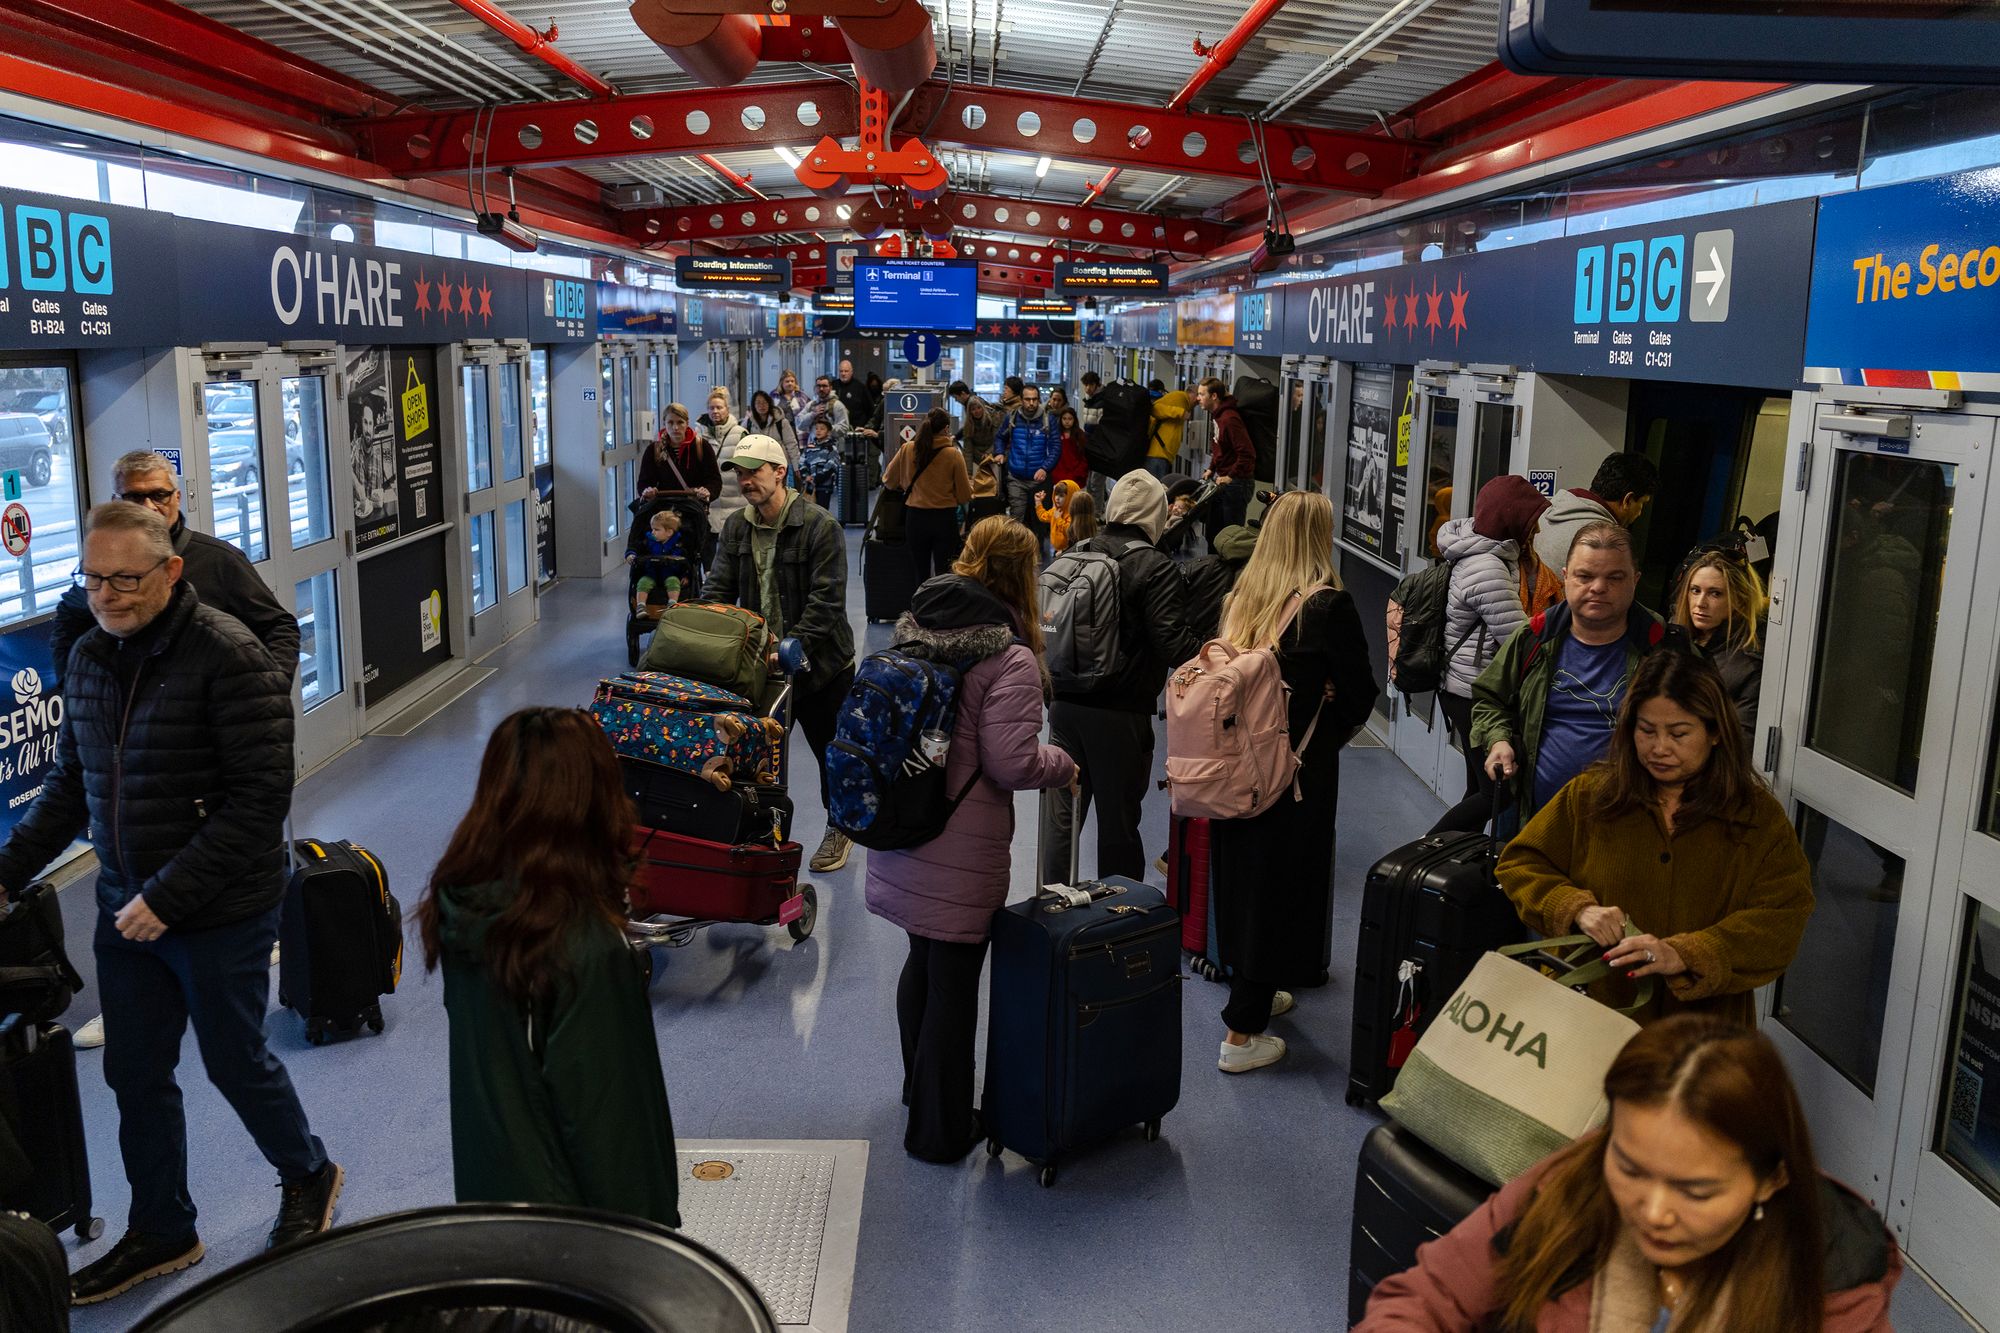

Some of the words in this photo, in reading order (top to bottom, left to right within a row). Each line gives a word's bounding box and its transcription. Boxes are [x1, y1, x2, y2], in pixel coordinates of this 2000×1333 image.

[27, 217, 57, 279] B
[78, 225, 105, 284] C
[692, 260, 728, 271] Boarding
[729, 261, 773, 271] Information
[882, 270, 921, 280] Terminal
[1072, 266, 1107, 276] Boarding
[1109, 267, 1152, 276] Information
[271, 246, 403, 327] O'HARE
[1583, 256, 1596, 312] 1
[1616, 252, 1636, 312] B
[1652, 246, 1677, 310] C
[1853, 253, 1911, 304] The
[32, 298, 60, 314] Gates
[82, 301, 108, 316] Gates
[568, 286, 574, 313] B
[577, 287, 584, 314] C
[1309, 282, 1375, 344] O'HARE
[30, 319, 65, 334] B1-B24
[80, 321, 111, 335] C1-C31
[1574, 331, 1600, 344] Terminal
[1612, 330, 1632, 345] Gates
[1649, 330, 1671, 346] Gates
[1609, 350, 1633, 365] B1-B24
[1645, 351, 1672, 367] C1-C31
[407, 392, 422, 411] OPEN
[407, 407, 425, 428] SHOPS
[8, 474, 15, 495] 1
[1531, 472, 1554, 480] DOOR
[1533, 481, 1550, 495] 12
[0, 694, 64, 750] SEMO
[9, 784, 46, 809] ROSEMO
[1443, 990, 1548, 1070] ALOHA
